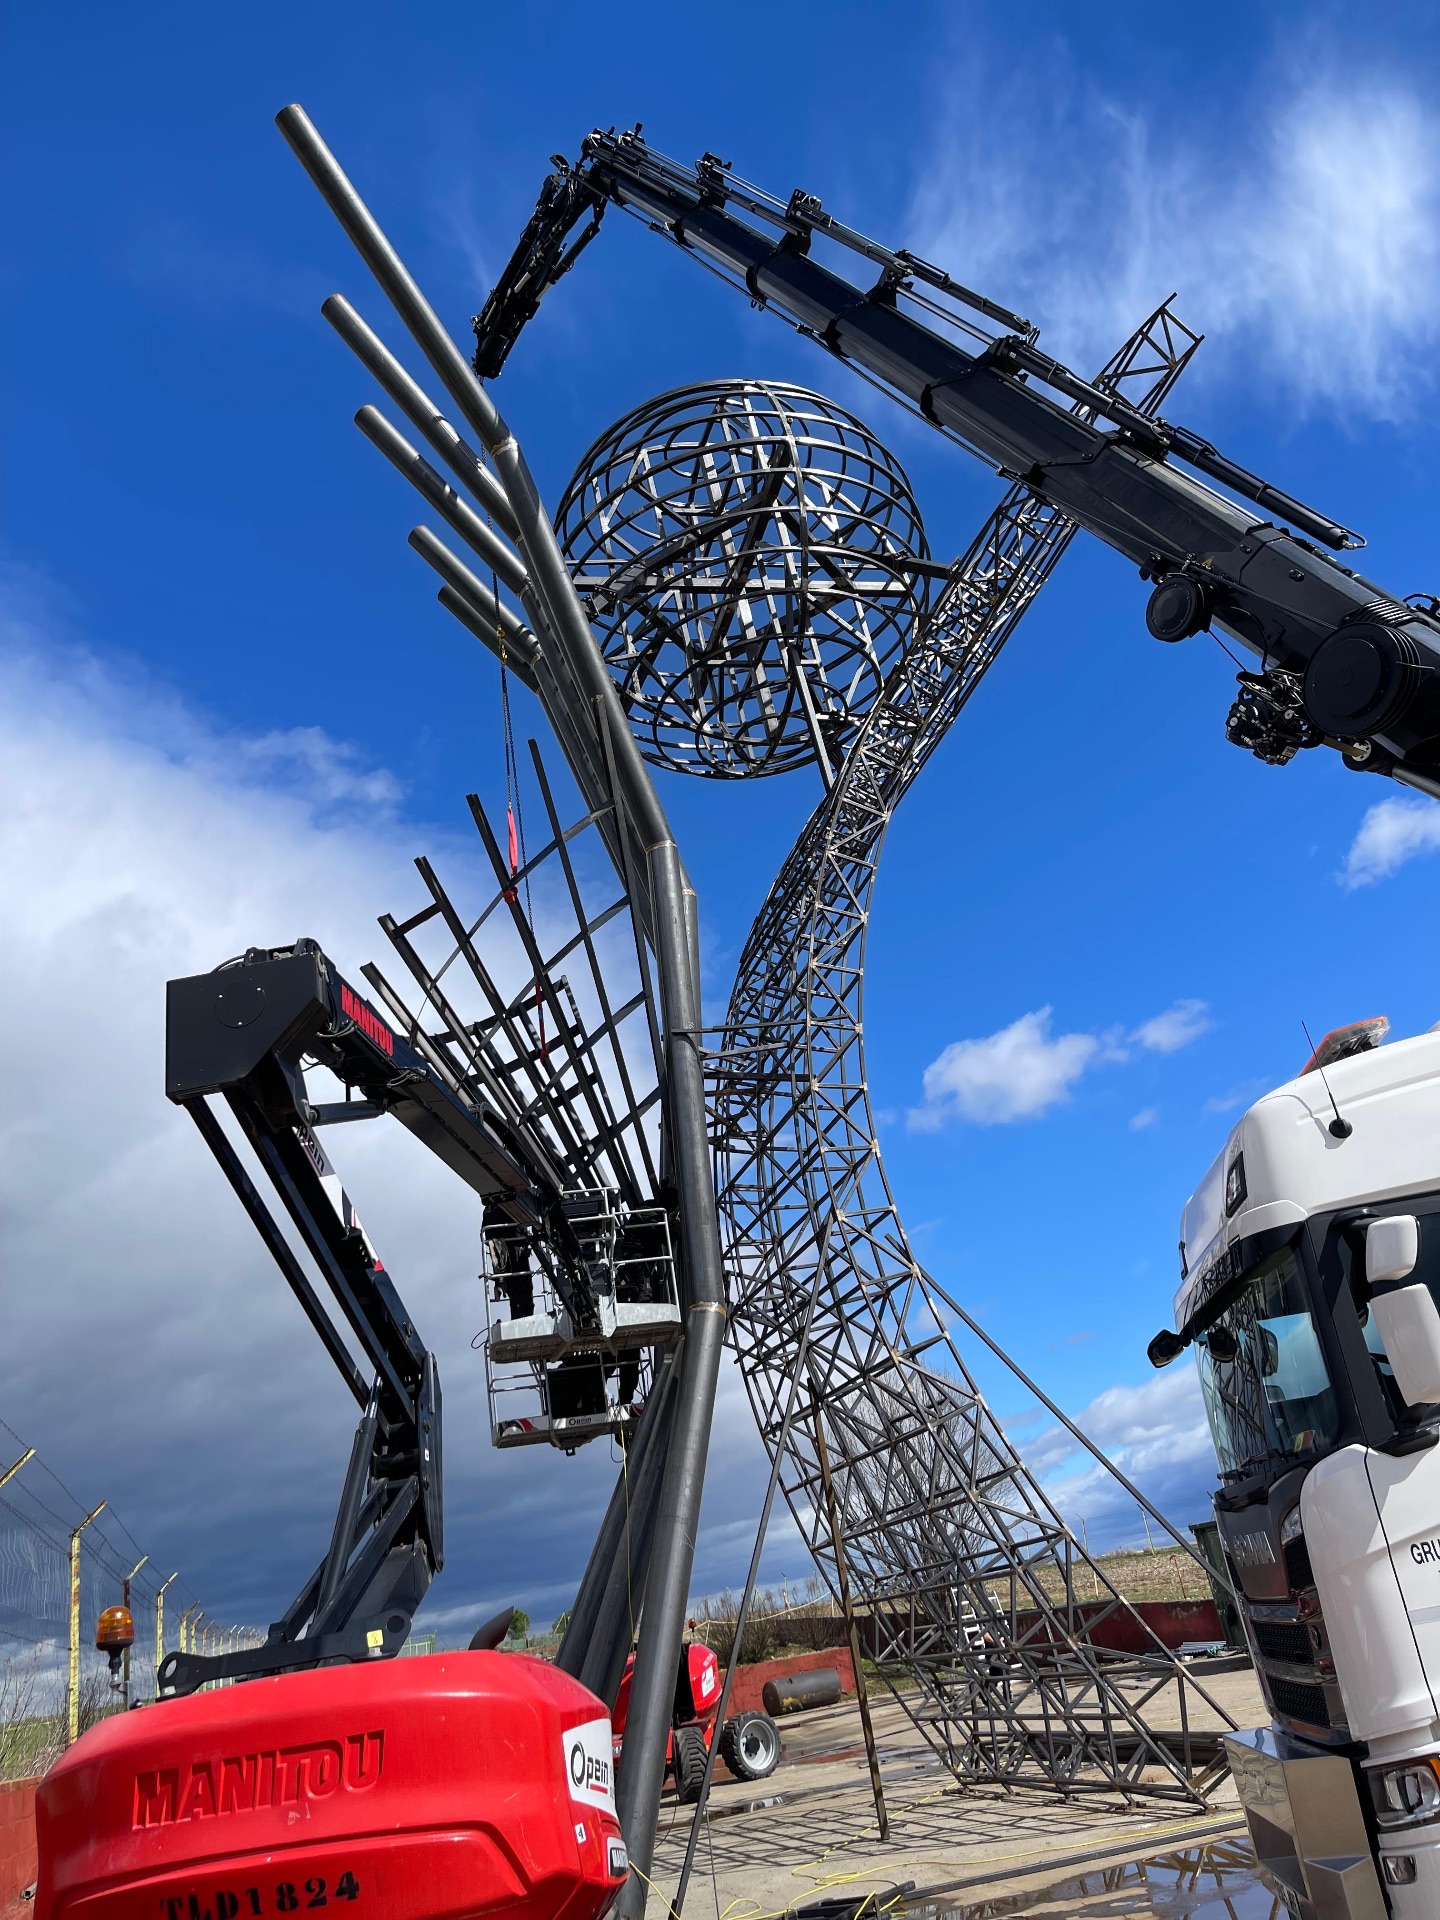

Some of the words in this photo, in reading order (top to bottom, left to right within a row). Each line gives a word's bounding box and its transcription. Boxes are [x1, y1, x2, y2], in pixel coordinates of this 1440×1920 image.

[341, 983, 394, 1057] MANITOU
[1233, 1531, 1276, 1567] SCANIA
[132, 1729, 386, 1830] MANITOU
[160, 1870, 360, 1920] TLD1824
